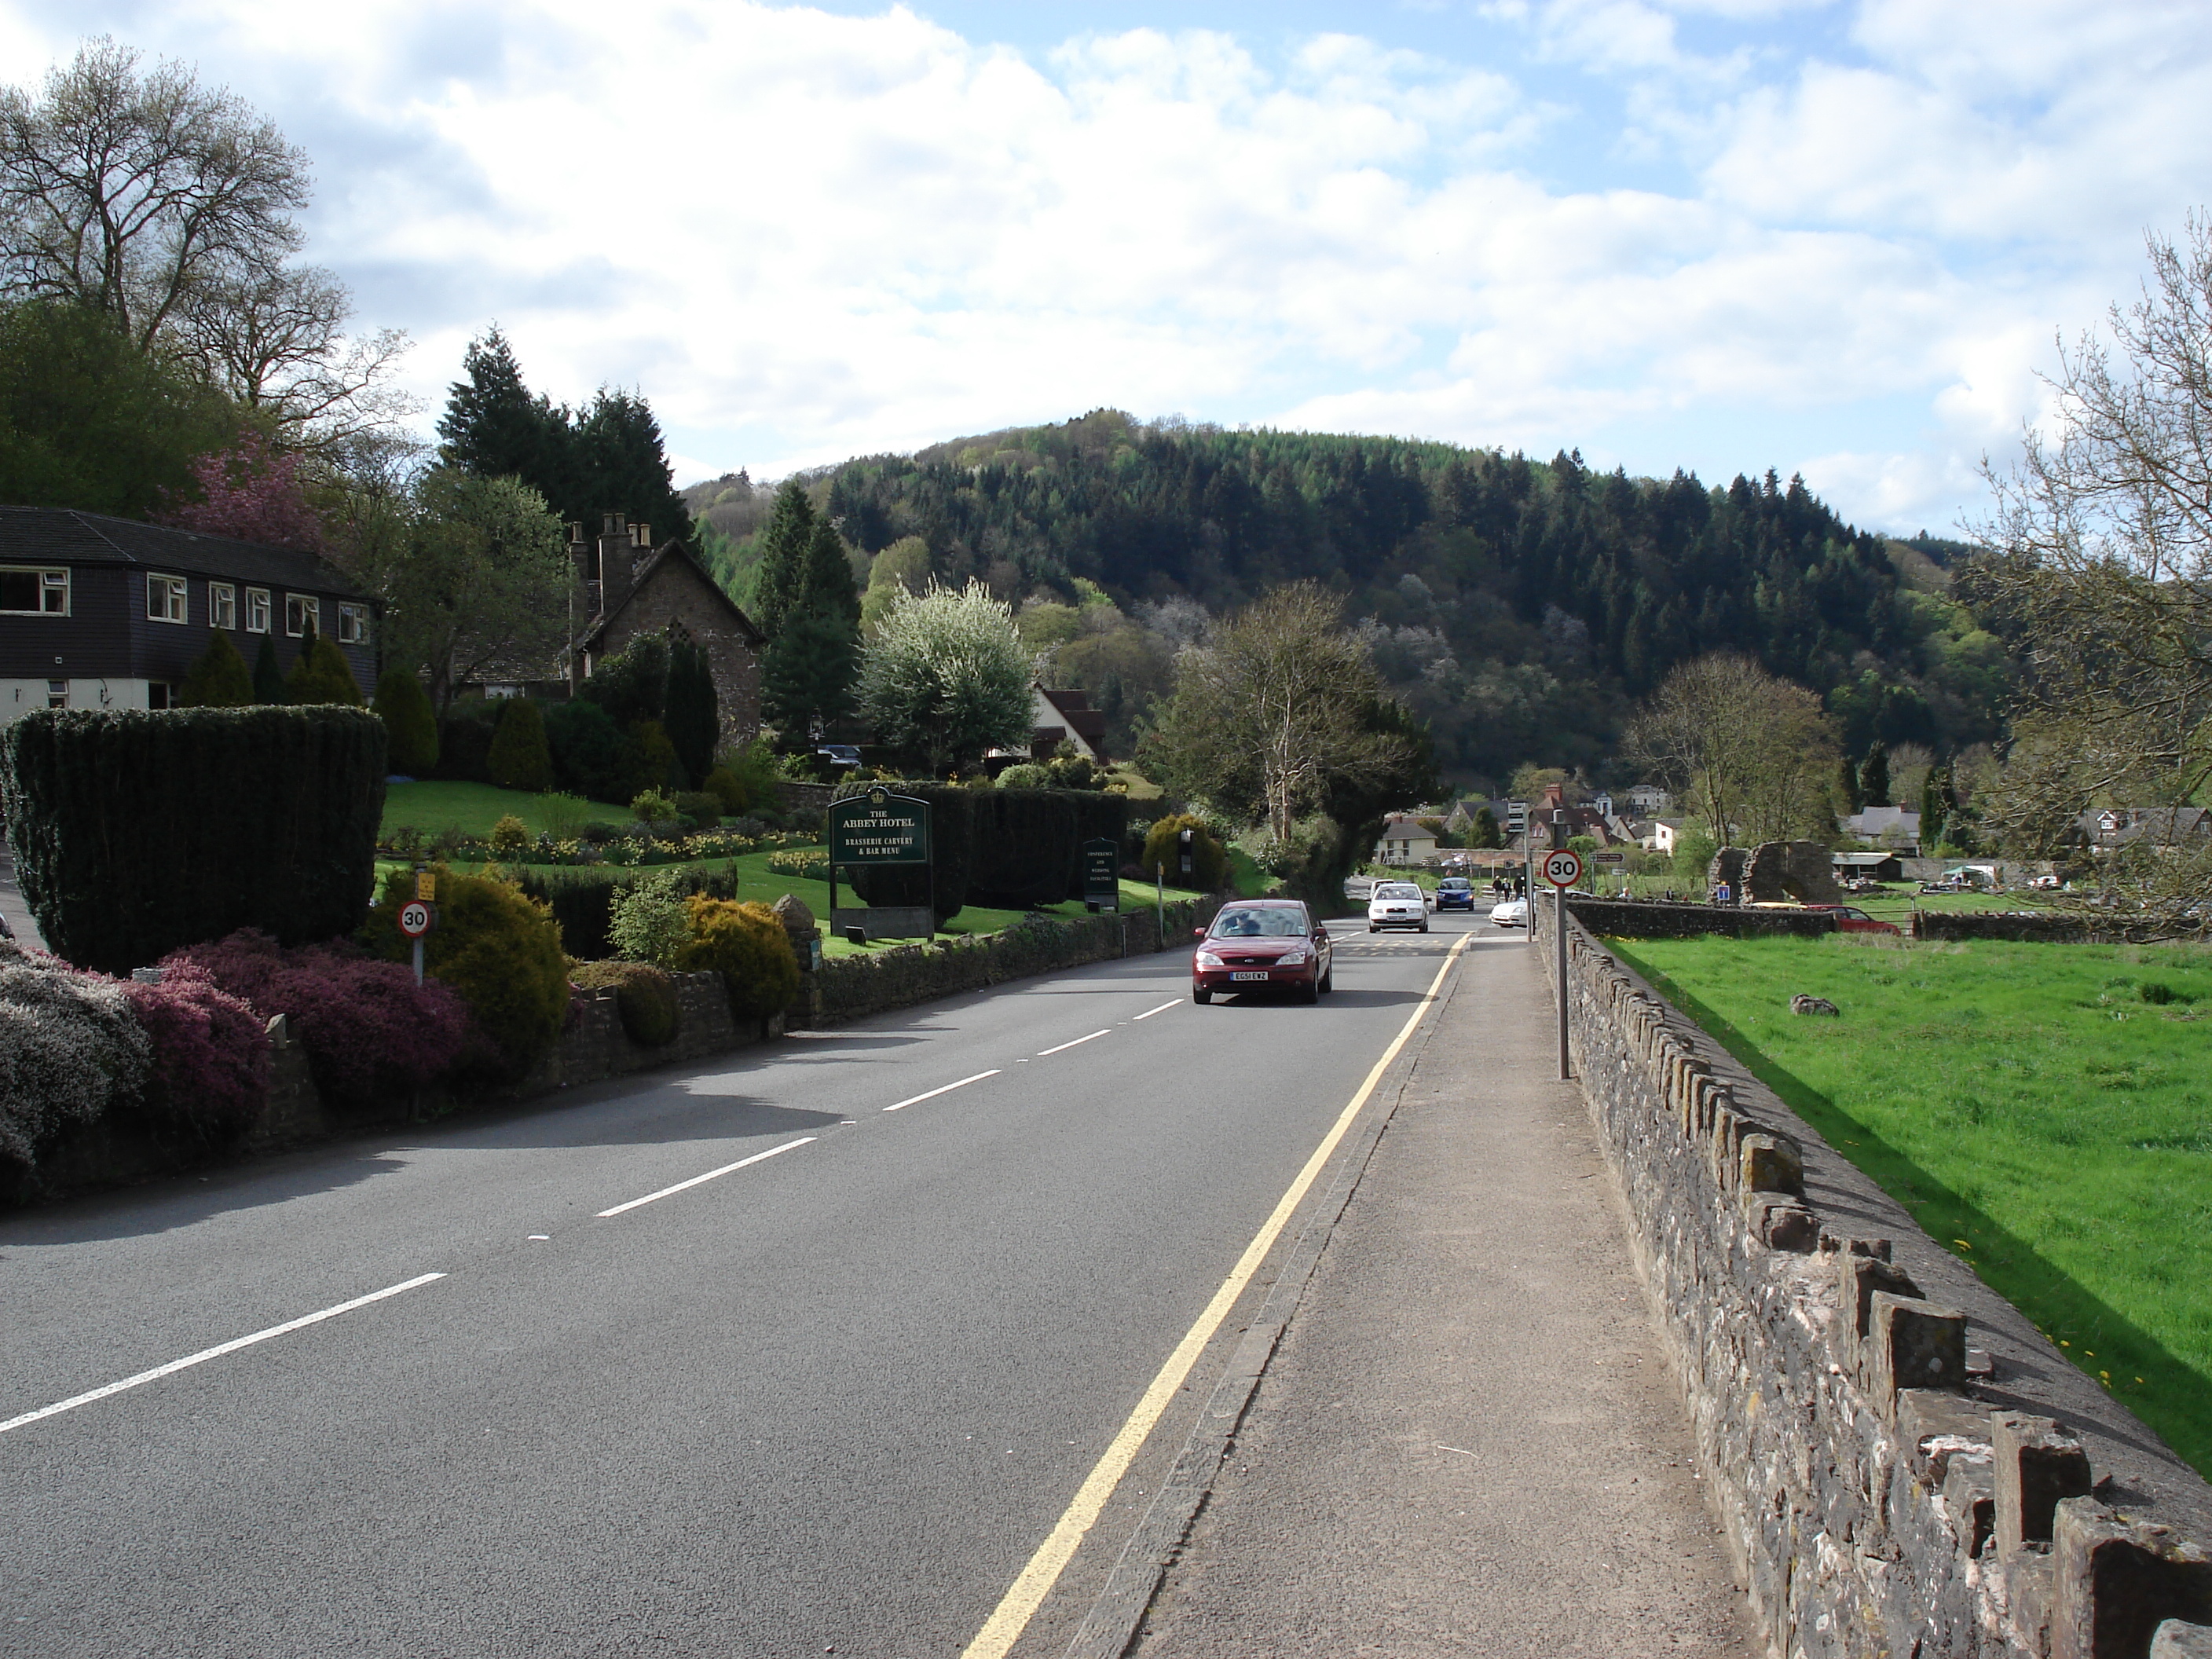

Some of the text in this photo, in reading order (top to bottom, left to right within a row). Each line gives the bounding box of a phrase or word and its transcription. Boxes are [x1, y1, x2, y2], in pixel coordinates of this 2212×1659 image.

[843, 819, 914, 828] ABBEY HOTEL
[884, 837, 913, 845] CARVERY
[1551, 861, 1575, 876] 30
[405, 911, 425, 926] 30
